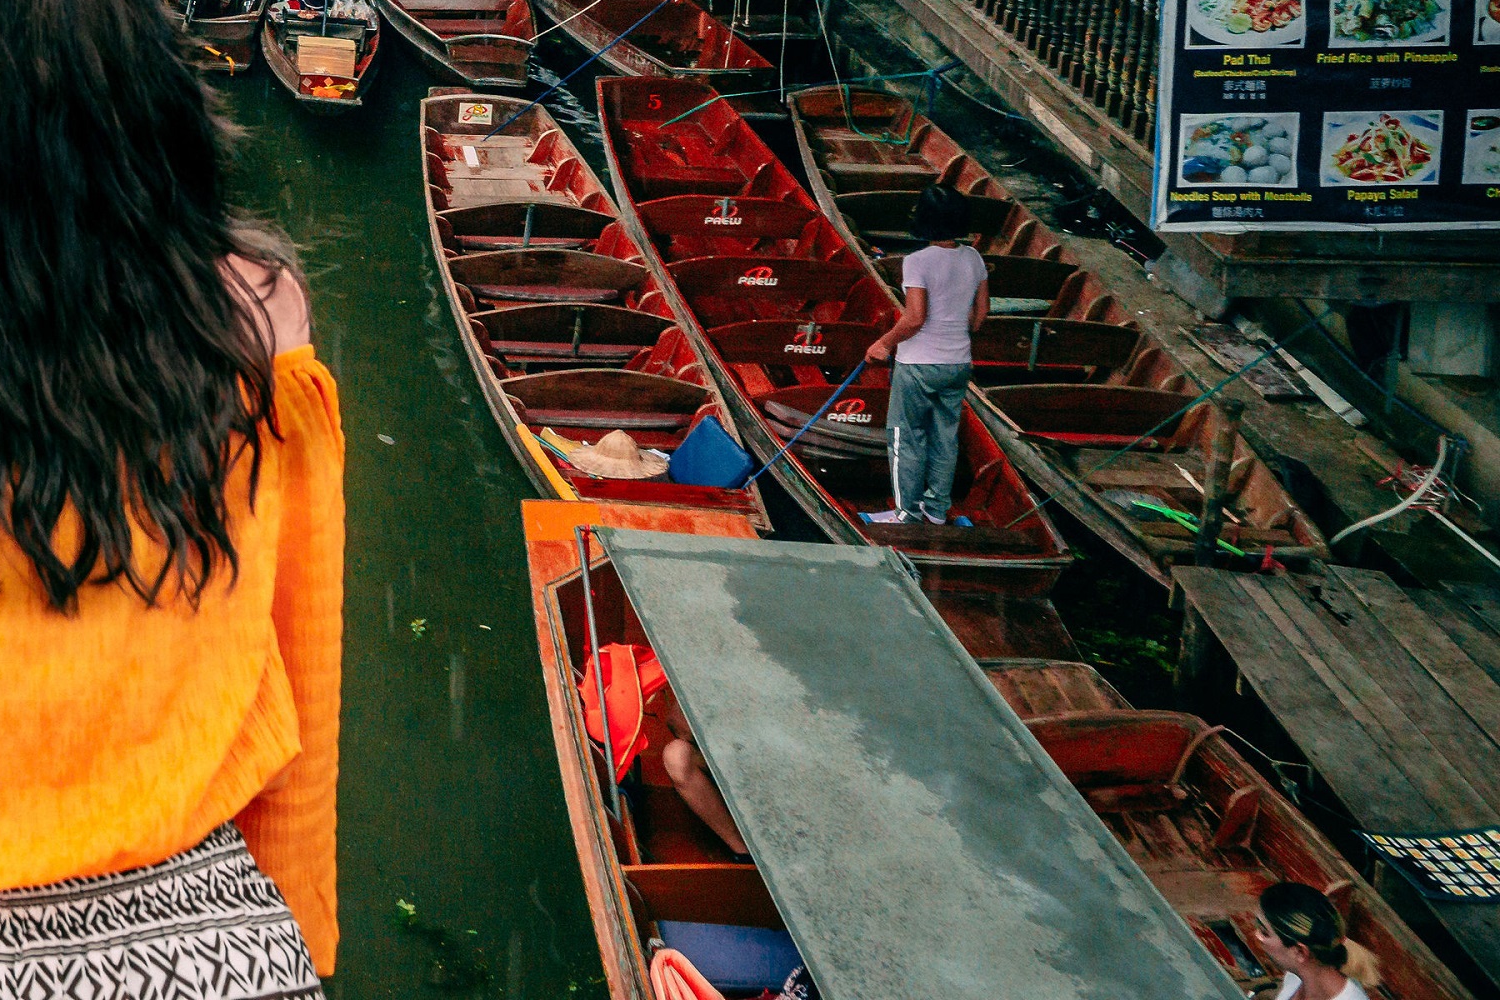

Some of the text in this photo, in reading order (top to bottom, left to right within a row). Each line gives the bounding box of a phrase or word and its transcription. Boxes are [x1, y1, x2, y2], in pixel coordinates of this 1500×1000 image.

[1223, 53, 1271, 66] Pad Thai
[1316, 51, 1458, 64] Fried Rice with Pineapple
[647, 94, 661, 110] 5
[1170, 191, 1312, 203] Noodles Soup with Meatballs
[1347, 188, 1419, 202] Papaya Salad
[704, 216, 742, 225] PAEW
[737, 275, 778, 286] PAEW
[784, 344, 826, 354] PAEW
[827, 412, 871, 422] PAEW
